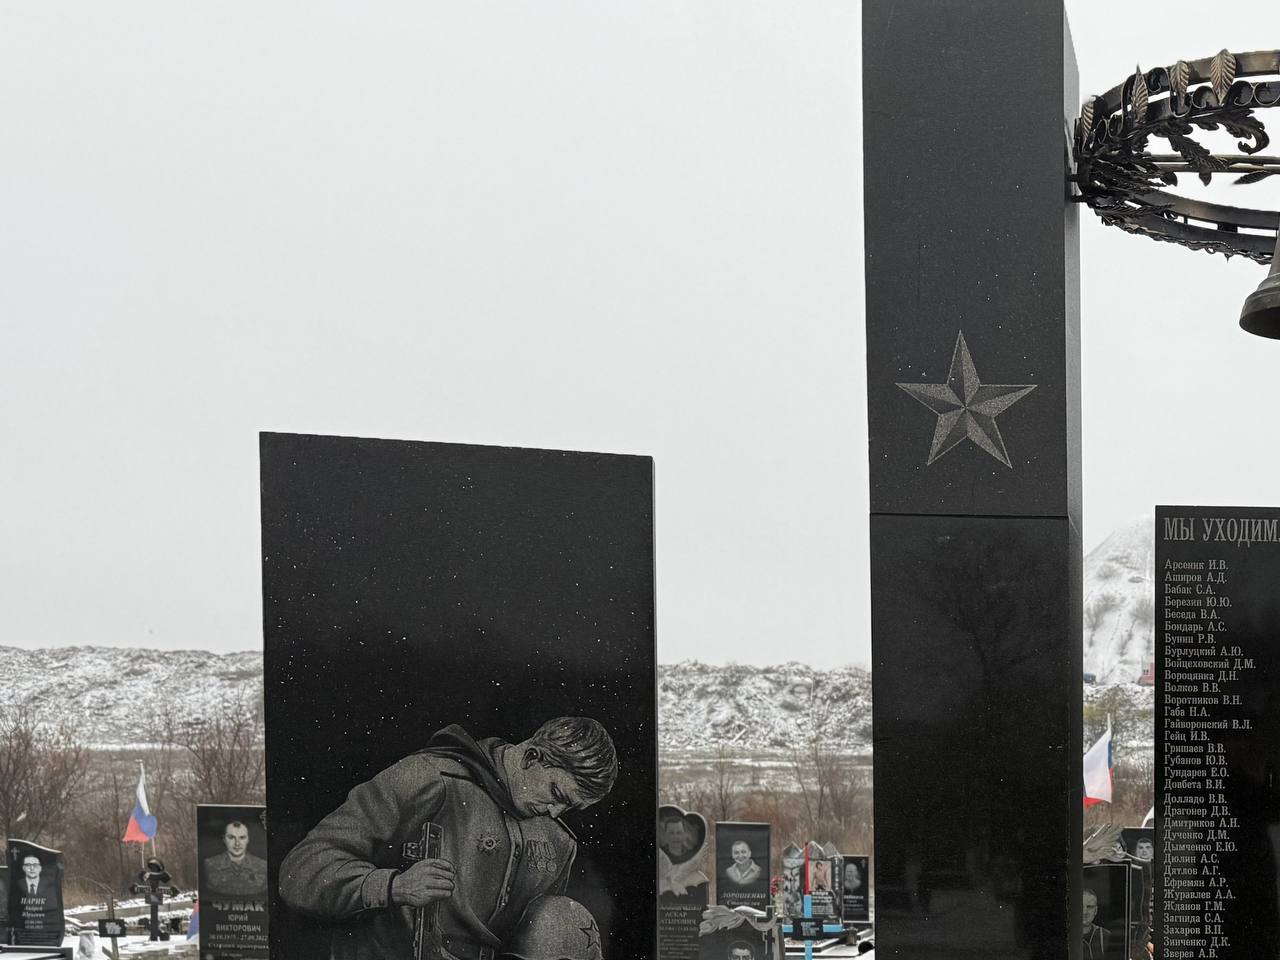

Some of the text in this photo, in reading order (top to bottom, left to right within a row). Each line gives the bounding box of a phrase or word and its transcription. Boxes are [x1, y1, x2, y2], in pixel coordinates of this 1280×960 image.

[1163, 517, 1195, 541] МЫ
[1165, 584, 1192, 594] Бабак
[1164, 596, 1202, 608] Березин
[1165, 608, 1197, 620] Беседа
[1165, 621, 1204, 634] Бондарь
[1164, 658, 1230, 670] Войцеховский
[1164, 682, 1199, 692] Волков
[1164, 694, 1219, 706] Воротников
[1164, 706, 1186, 716] Габа
[1164, 718, 1228, 730] Гайворонский
[1164, 754, 1202, 766] Губанов
[1163, 841, 1212, 852] Дымченко
[1163, 865, 1198, 876] Дятлов
[1163, 889, 1211, 902] Журавлев
[211, 901, 265, 912] ЧУМАК
[1163, 901, 1201, 912] Жданов
[227, 913, 249, 922] ЮРИЙ
[215, 924, 261, 933] ВИКТОРОВИЧ
[1163, 924, 1201, 936] Захаров
[1163, 936, 1207, 946] Зинченко
[1163, 948, 1195, 960] Зверев
